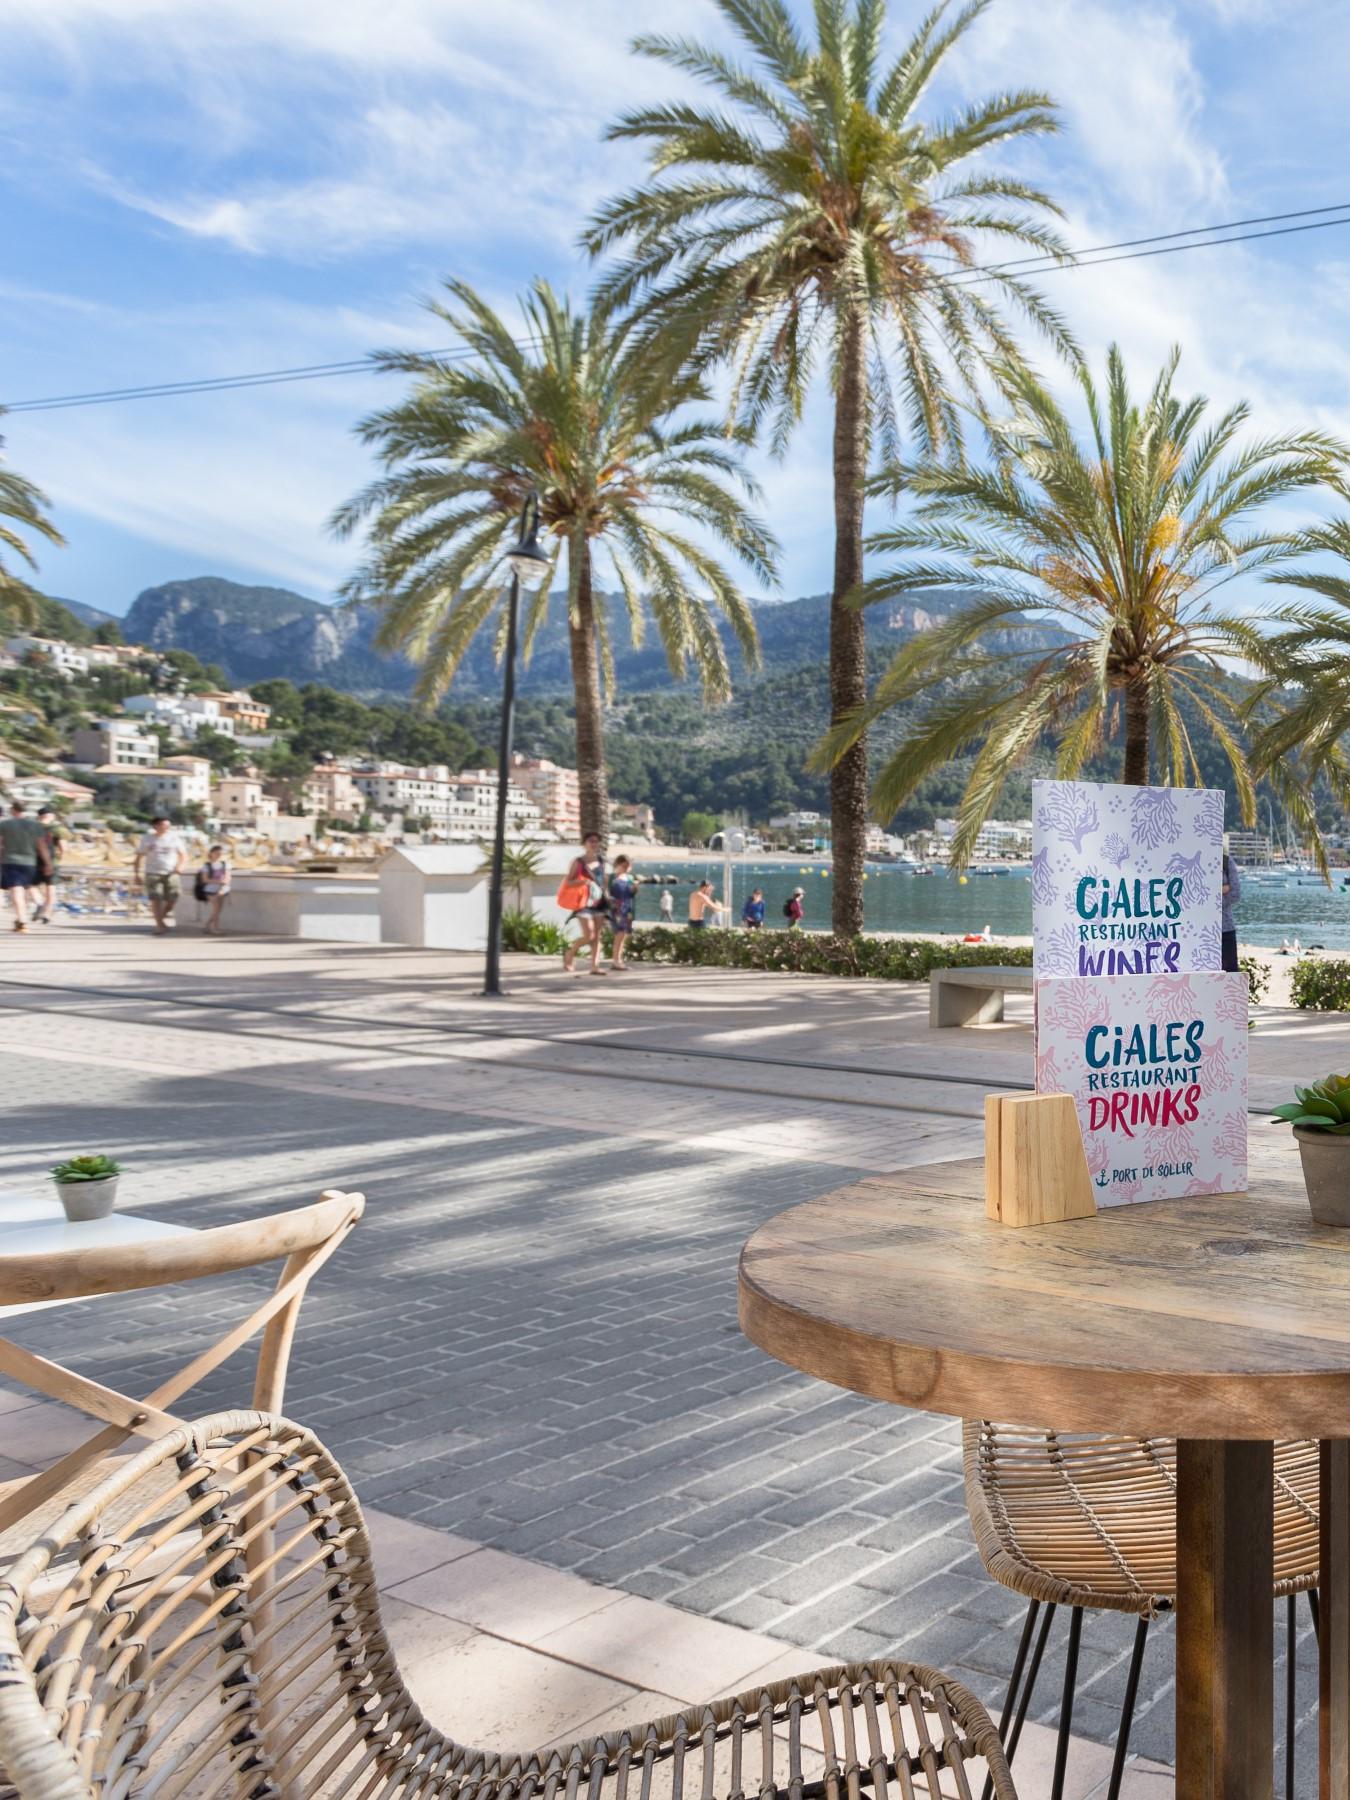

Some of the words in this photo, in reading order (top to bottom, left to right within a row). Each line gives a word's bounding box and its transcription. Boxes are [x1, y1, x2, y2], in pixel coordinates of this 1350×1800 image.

[1078, 922, 1182, 942] RESTAURANT
[1087, 1065, 1202, 1091] RESTAURANT
[1088, 1084, 1202, 1138] DRINKS
[1113, 1168, 1138, 1183] PORT
[1142, 1166, 1154, 1179] DE
